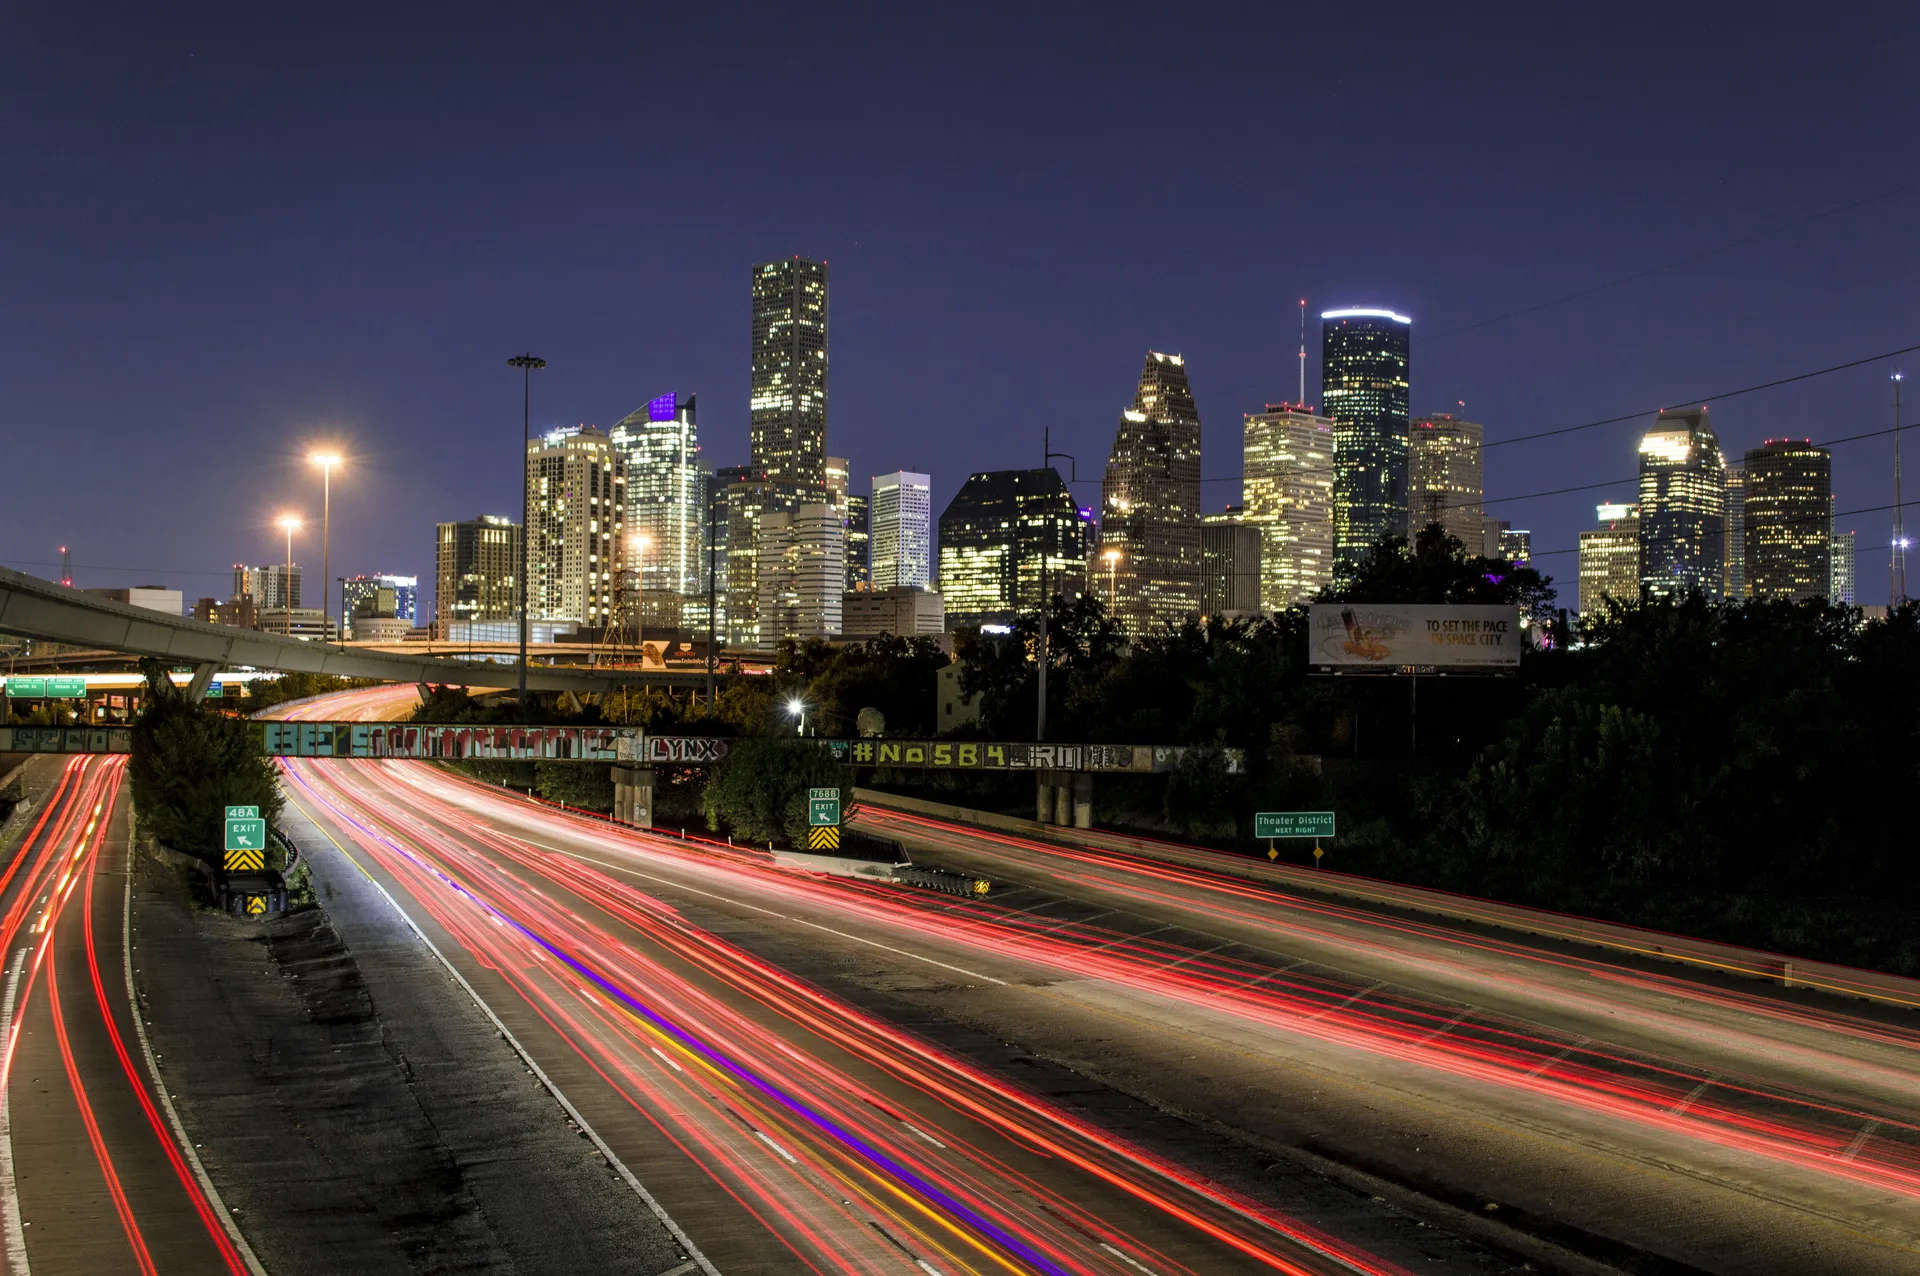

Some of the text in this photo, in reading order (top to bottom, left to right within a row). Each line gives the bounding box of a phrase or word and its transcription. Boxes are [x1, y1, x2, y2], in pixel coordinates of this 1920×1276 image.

[1426, 620, 1508, 632] TO SET THE PACE
[1431, 633, 1503, 646] IN SPACE CITY.
[650, 737, 720, 761] LYNX
[813, 790, 837, 798] 768B
[229, 808, 254, 817] 48A
[1258, 815, 1332, 824] Theater District
[233, 824, 257, 832] EXIT
